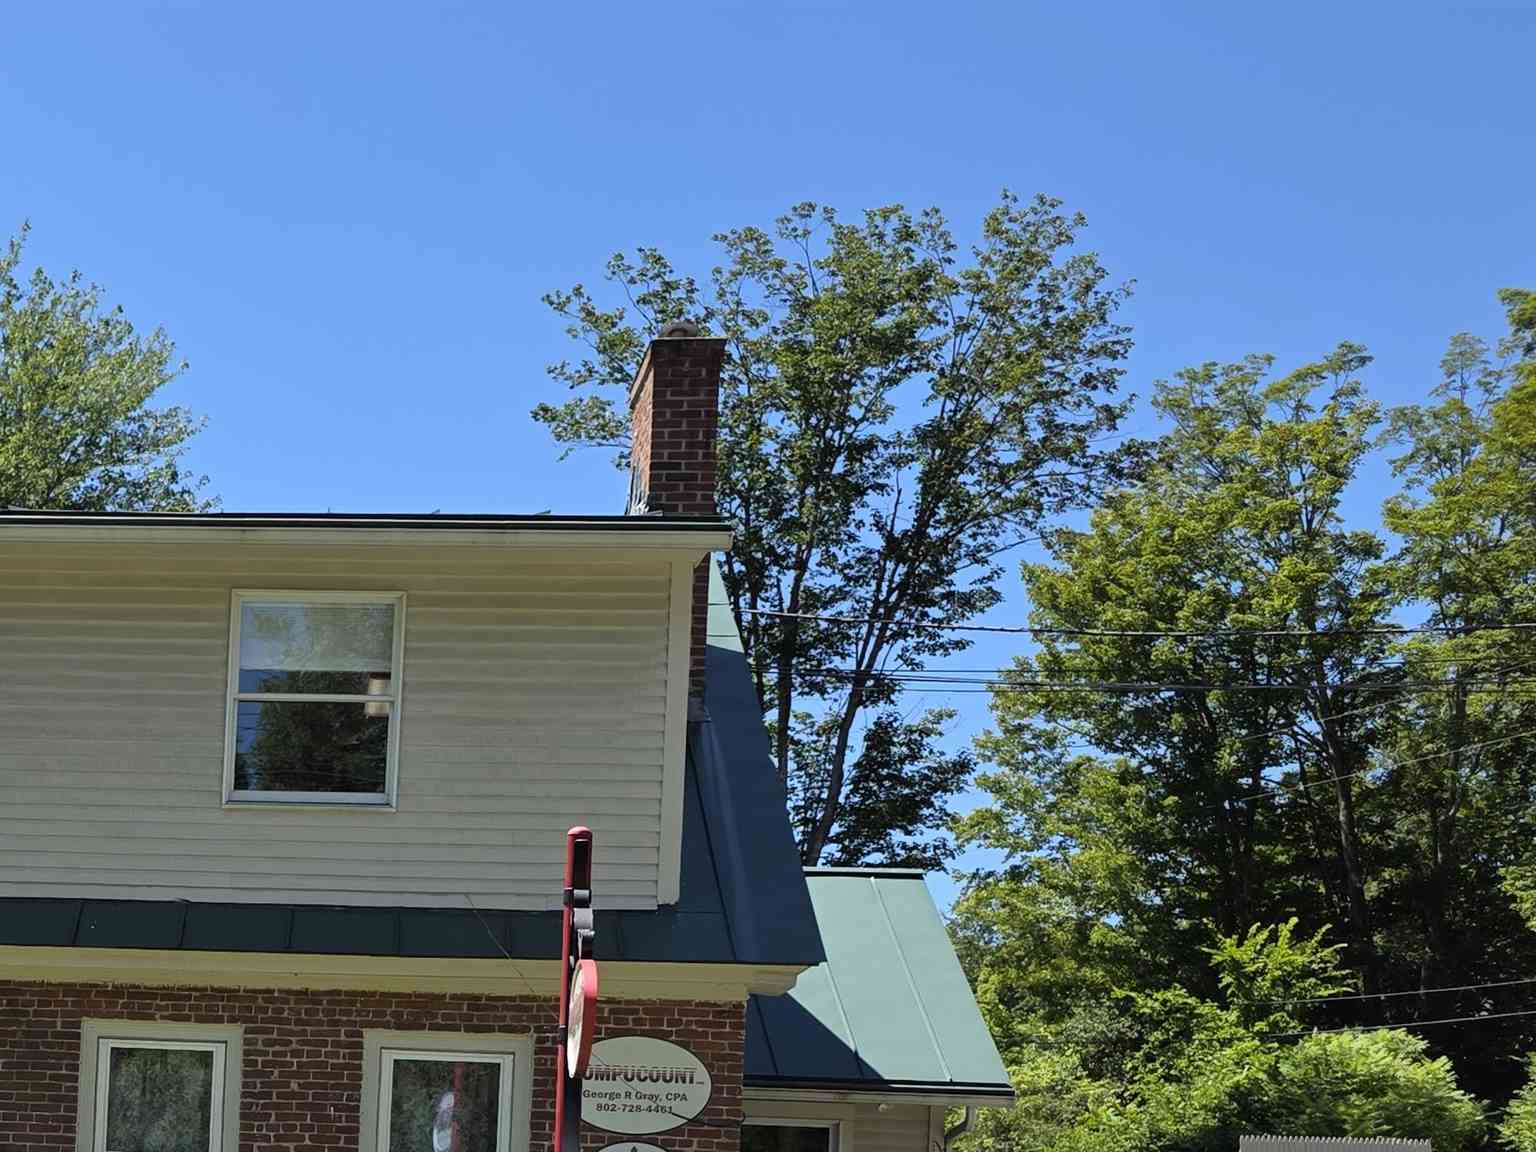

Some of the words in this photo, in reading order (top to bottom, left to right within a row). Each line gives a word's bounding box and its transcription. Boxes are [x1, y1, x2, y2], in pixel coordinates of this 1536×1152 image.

[584, 1064, 697, 1085] OMPUCOUNT
[583, 1089, 622, 1101] George
[624, 1091, 632, 1100] R
[635, 1091, 663, 1104] Gray,
[665, 1092, 689, 1102] CPA
[595, 1103, 673, 1114] 802-728-4461
